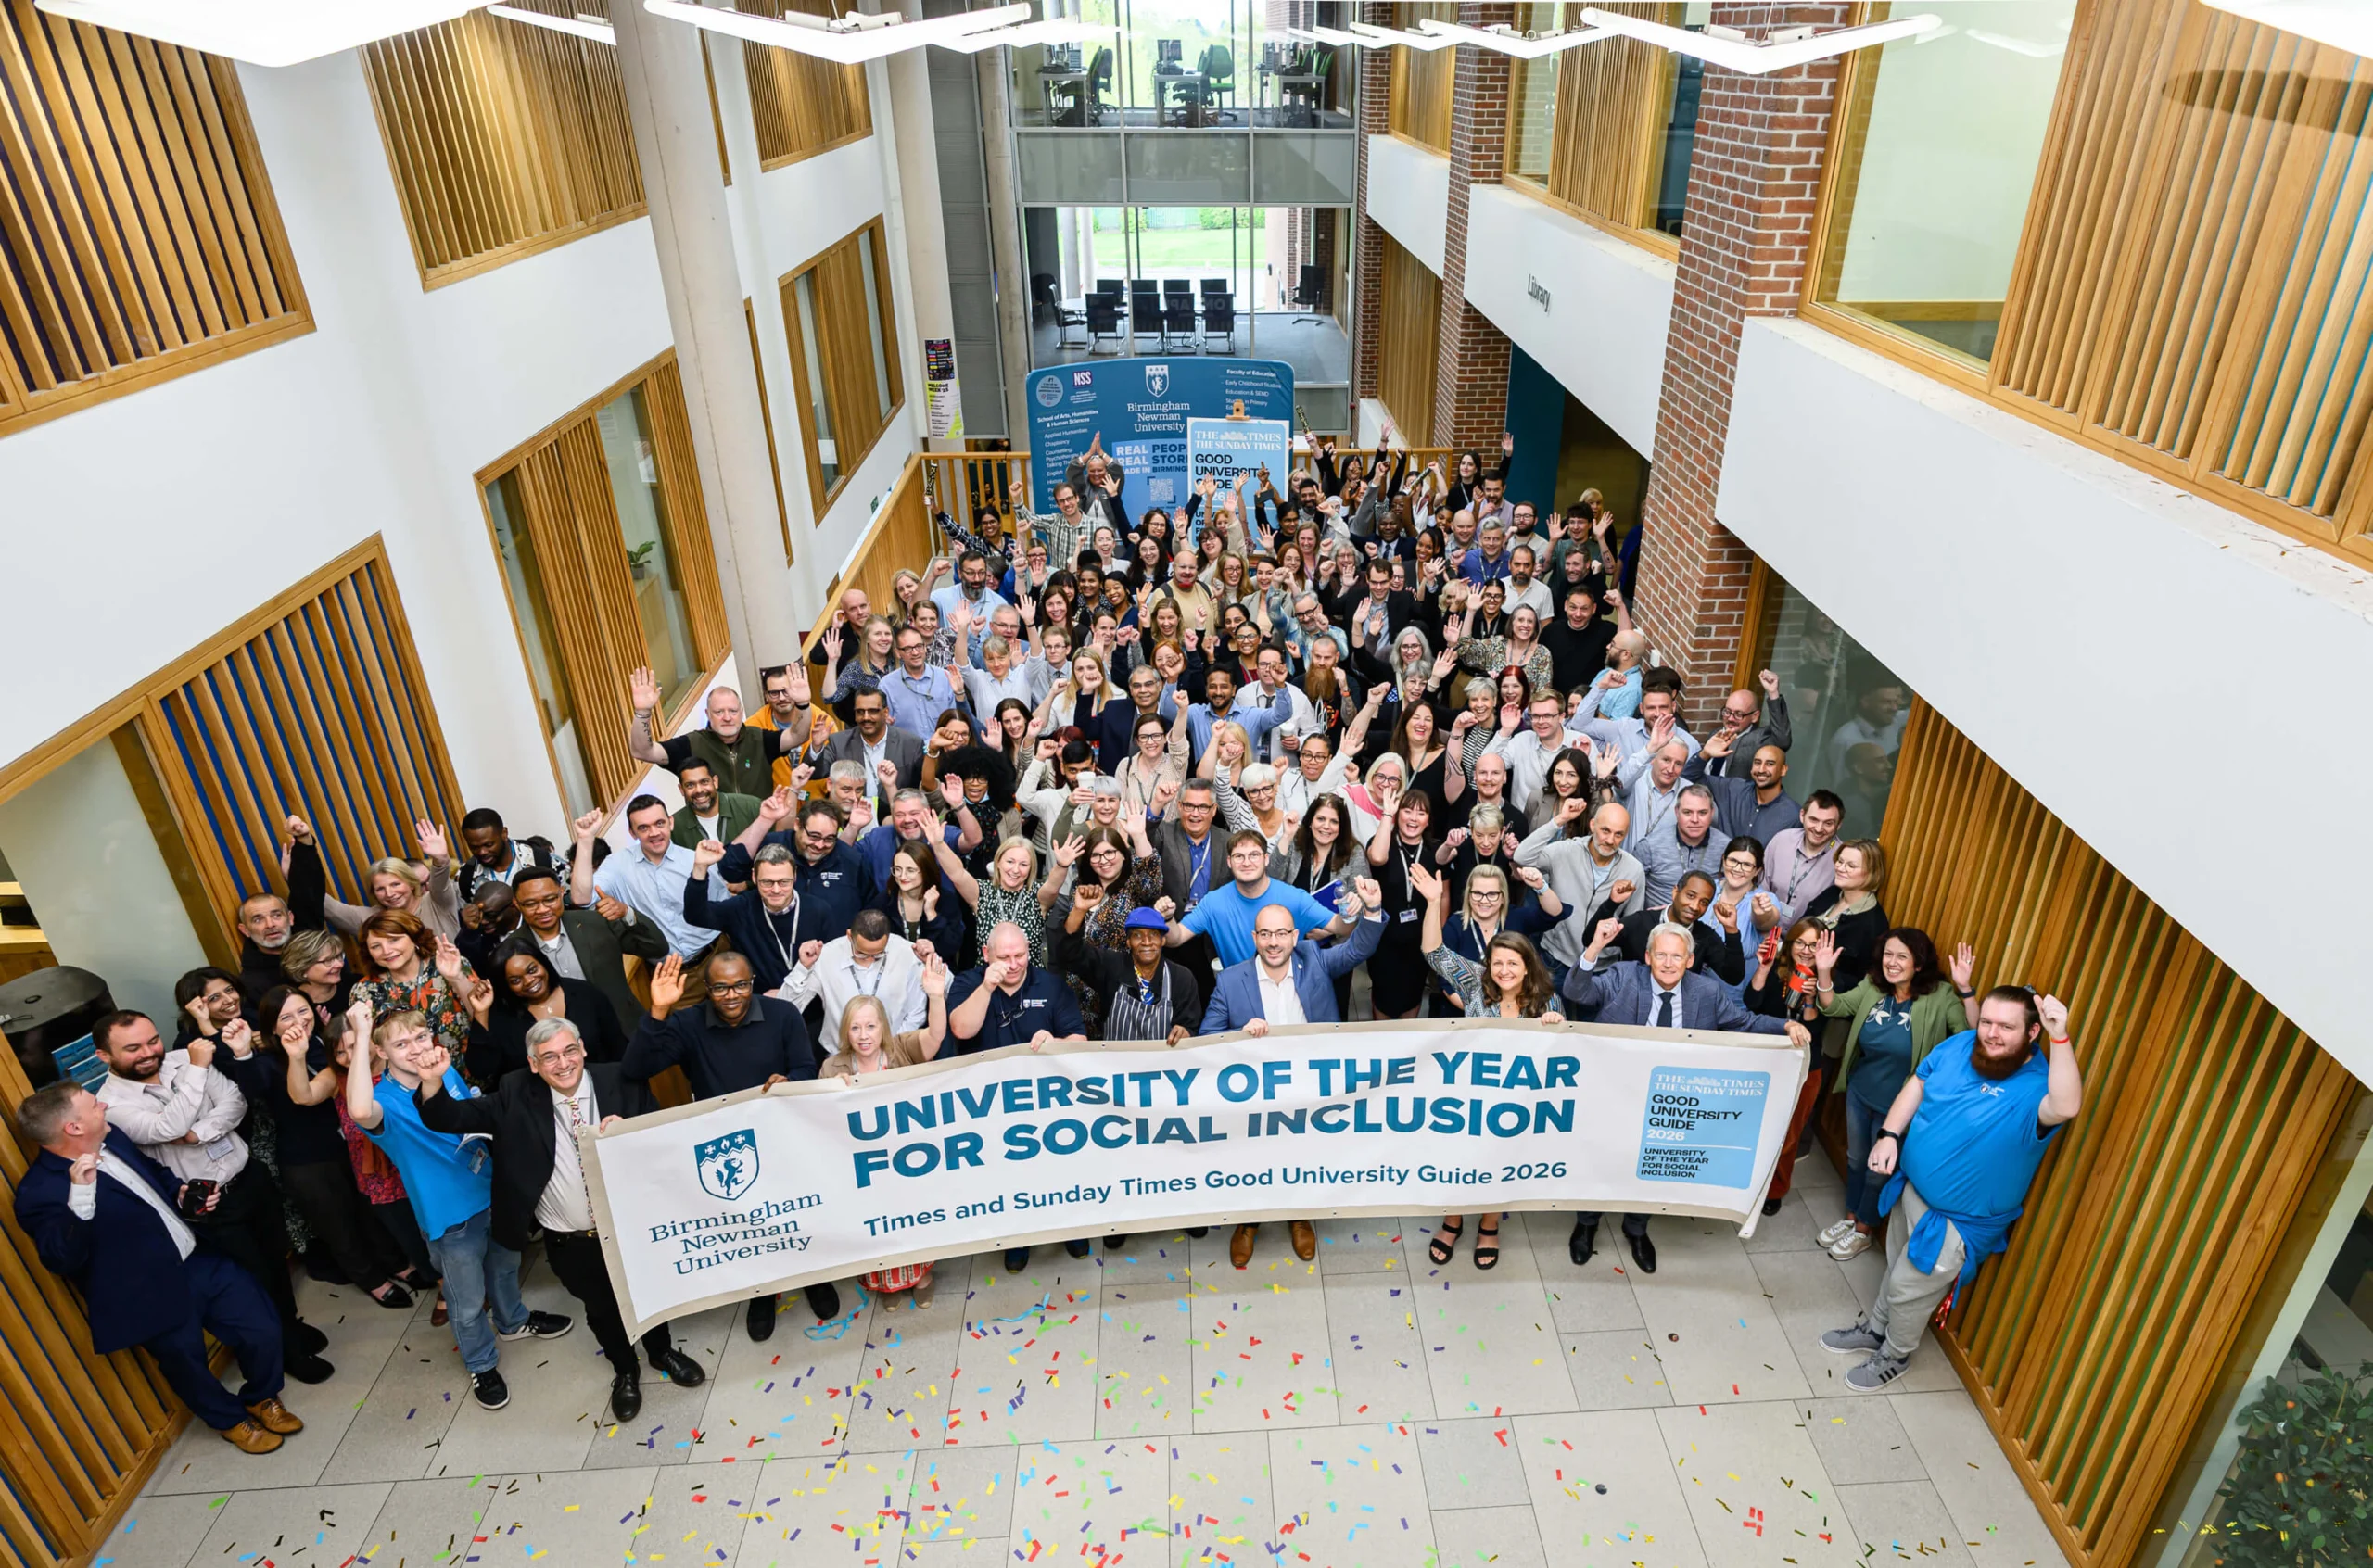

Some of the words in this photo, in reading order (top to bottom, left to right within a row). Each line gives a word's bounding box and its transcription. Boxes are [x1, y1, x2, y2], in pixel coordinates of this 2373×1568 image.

[1528, 273, 1551, 312] Library
[1073, 371, 1092, 386] NSS
[1127, 400, 1190, 412] Birmingham
[1137, 412, 1181, 422] Newman
[1134, 422, 1185, 433] University
[1195, 431, 1218, 439] THE
[1247, 432, 1281, 441] TIMES
[1116, 445, 1148, 456] REAL
[1152, 444, 1186, 453] PEOP
[1195, 440, 1213, 449] THE
[1214, 441, 1252, 450] SUNDAY
[1252, 442, 1281, 450] TIMES
[1118, 456, 1148, 466] REAL
[1195, 453, 1233, 464] GOOD
[1196, 466, 1268, 478] UNIVERSIT
[1656, 1074, 1686, 1083] THE
[1721, 1079, 1765, 1088] TIMES
[1655, 1082, 1679, 1091] THE
[1680, 1084, 1726, 1095] SUNDAY
[1729, 1088, 1763, 1096] TIMES
[847, 1068, 1200, 1140] UNIVERSITY
[1217, 1060, 1292, 1102] OF
[1309, 1056, 1416, 1096] THE
[1431, 1051, 1580, 1090] YEAR
[1652, 1094, 1700, 1106] GOOD
[1651, 1106, 1742, 1120] UNIVERSITY
[1649, 1118, 1695, 1130] GUIDE
[1646, 1129, 1685, 1141] 2026
[853, 1132, 984, 1188] FOR
[1003, 1115, 1227, 1160] SOCIAL
[1248, 1097, 1575, 1137] INCLUSION
[1644, 1148, 1706, 1157] UNIVERSITY
[1665, 1163, 1701, 1171] SOCIAL
[1641, 1170, 1695, 1178] INCLUSION
[864, 1208, 946, 1236] Times
[955, 1195, 1004, 1219] and
[1013, 1184, 1111, 1210] Sunday
[1120, 1174, 1196, 1196] Times
[1205, 1169, 1273, 1188] Good
[1282, 1165, 1409, 1185] University
[1417, 1165, 1492, 1185] Guide
[1501, 1162, 1567, 1182] 2026
[649, 1193, 823, 1243] Birmingham
[680, 1220, 800, 1254] Newman
[673, 1236, 812, 1275] University
